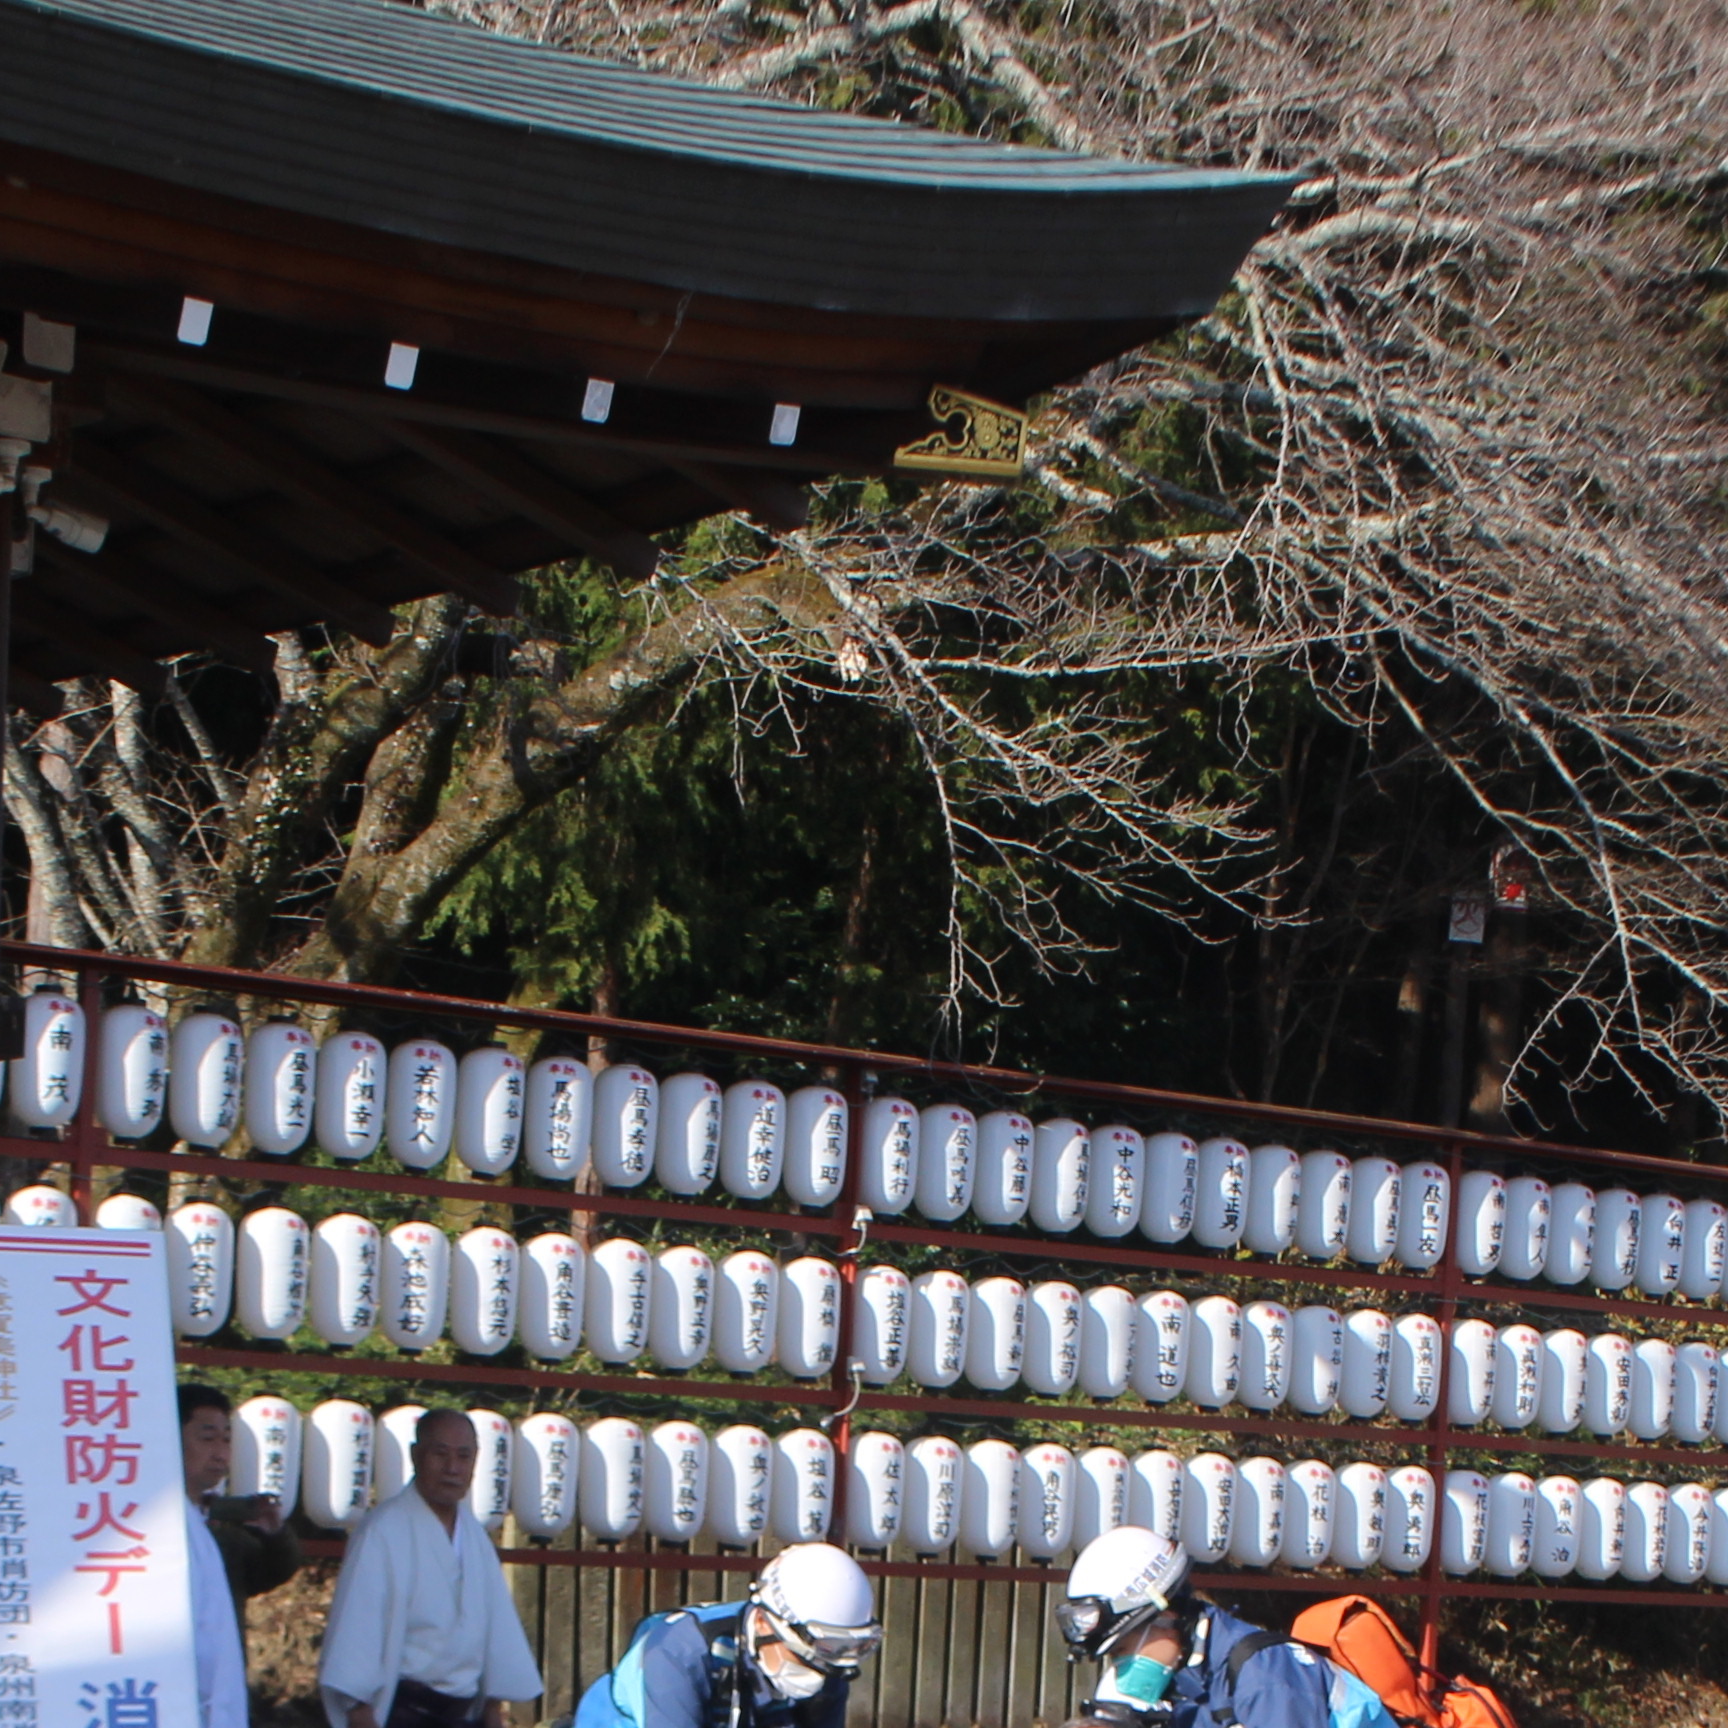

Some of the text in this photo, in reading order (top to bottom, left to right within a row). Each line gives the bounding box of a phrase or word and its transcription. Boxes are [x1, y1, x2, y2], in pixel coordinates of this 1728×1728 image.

[54, 1269, 150, 1655] 文化財防火デー
